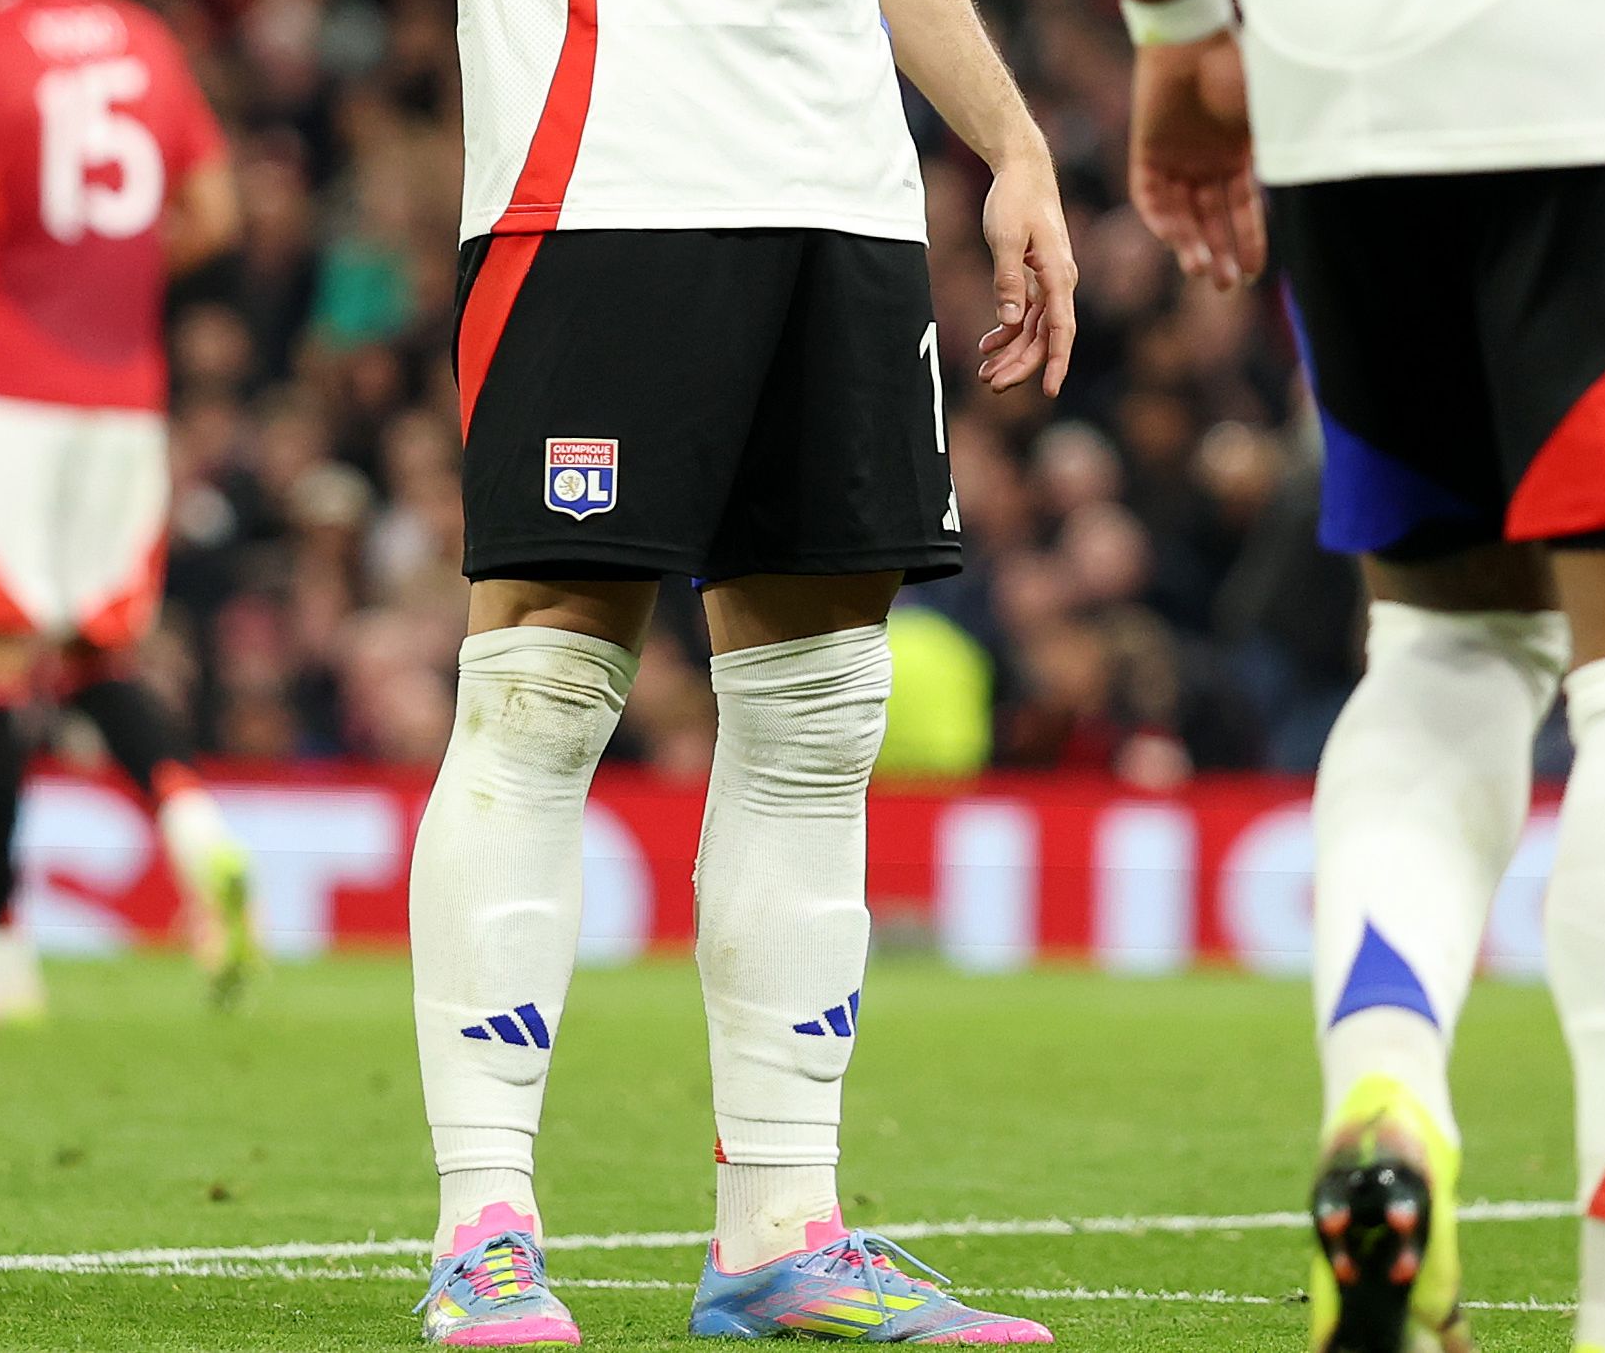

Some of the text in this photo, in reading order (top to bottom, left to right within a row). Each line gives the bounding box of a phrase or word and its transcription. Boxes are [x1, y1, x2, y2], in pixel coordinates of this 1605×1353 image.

[36, 57, 165, 243] 15
[552, 444, 612, 455] OLYMPIQUE
[553, 454, 612, 465] LYONNAIS
[553, 469, 609, 503] OL
